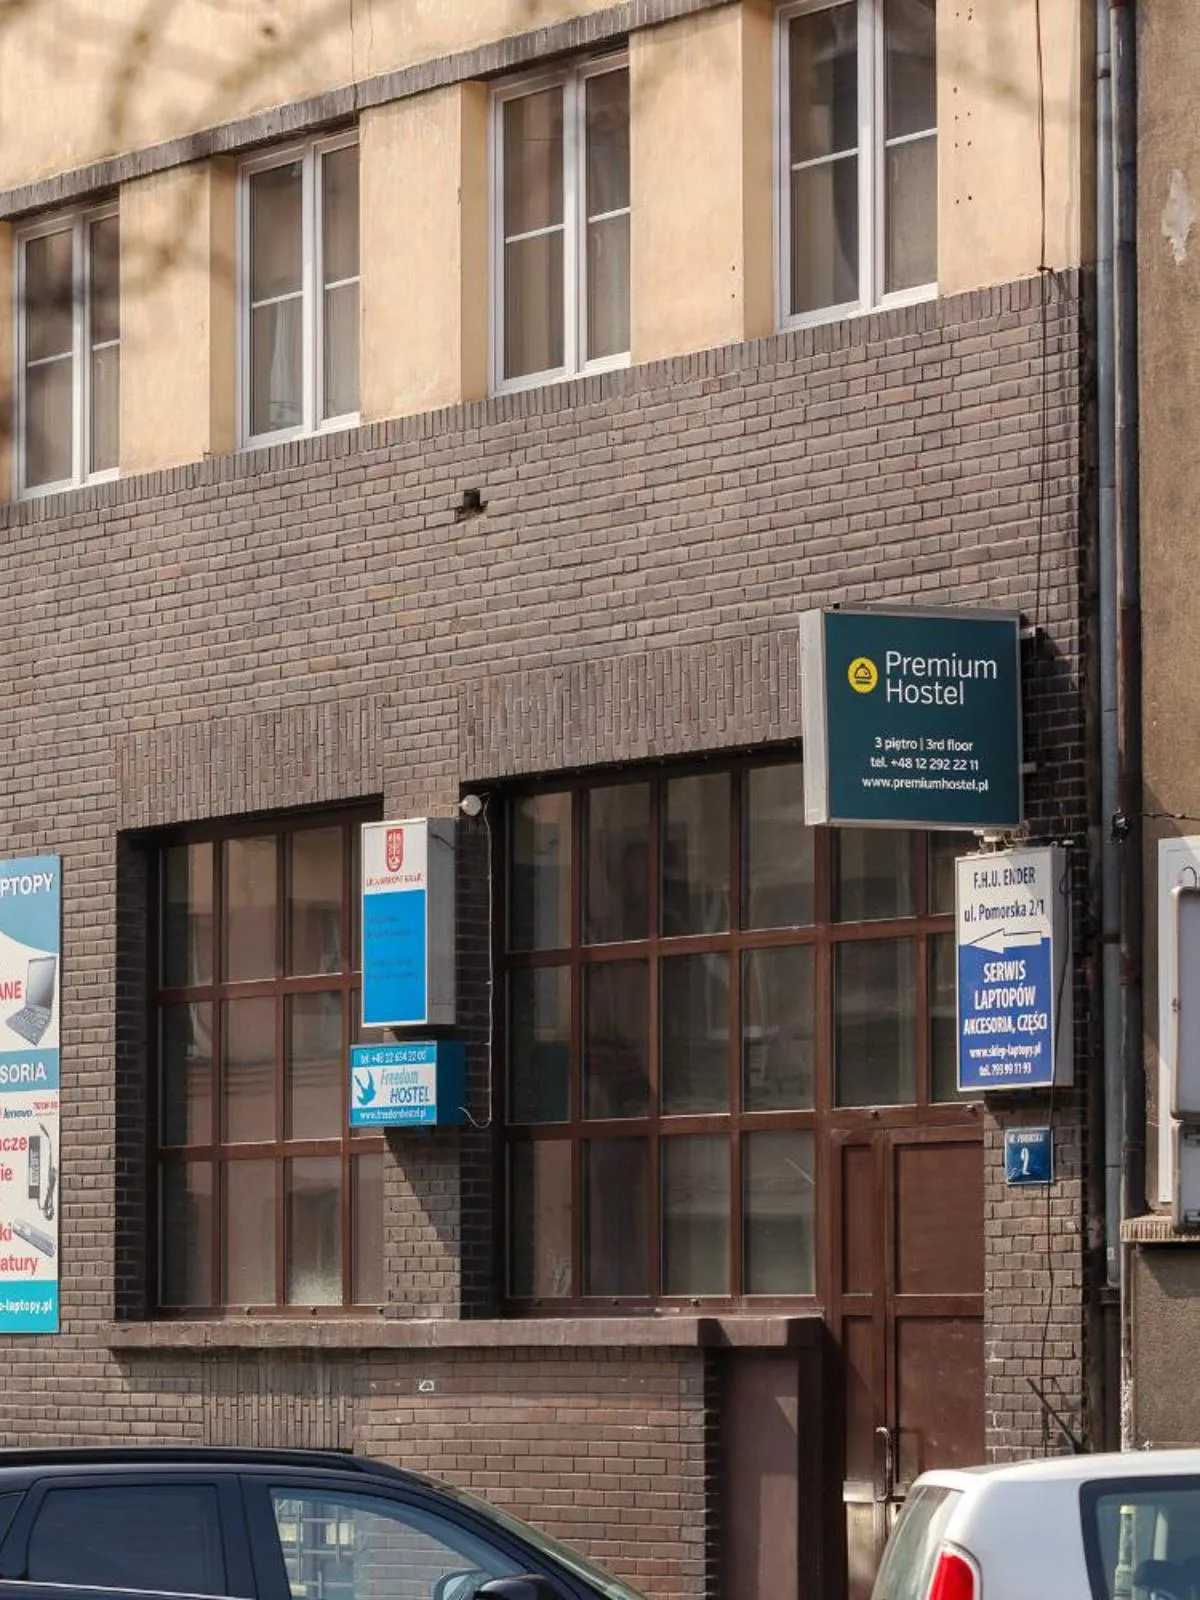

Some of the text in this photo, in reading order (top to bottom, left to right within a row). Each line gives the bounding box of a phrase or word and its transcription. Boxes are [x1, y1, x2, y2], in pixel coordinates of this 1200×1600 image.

[886, 651, 997, 679] Premium
[886, 678, 964, 705] Hostel
[874, 737, 882, 748] 3
[885, 737, 917, 751] piętro
[926, 739, 944, 750] 3rd
[947, 739, 973, 751] floor
[870, 756, 979, 771] tel. +48 12 292 22 11
[862, 777, 988, 793] www.premiumhostel.pl
[974, 866, 1036, 889] F.H.U. ENDER
[964, 904, 976, 922] ul.
[979, 900, 1026, 920] Pomorska
[983, 960, 1026, 983] SERWIS
[974, 982, 1036, 1010] LAPTOPÓW
[1017, 1011, 1048, 1035] CZĘŚCI
[381, 1066, 419, 1086] Freedom
[390, 1086, 430, 1104] HOSTEL
[1020, 1147, 1032, 1175] 2
